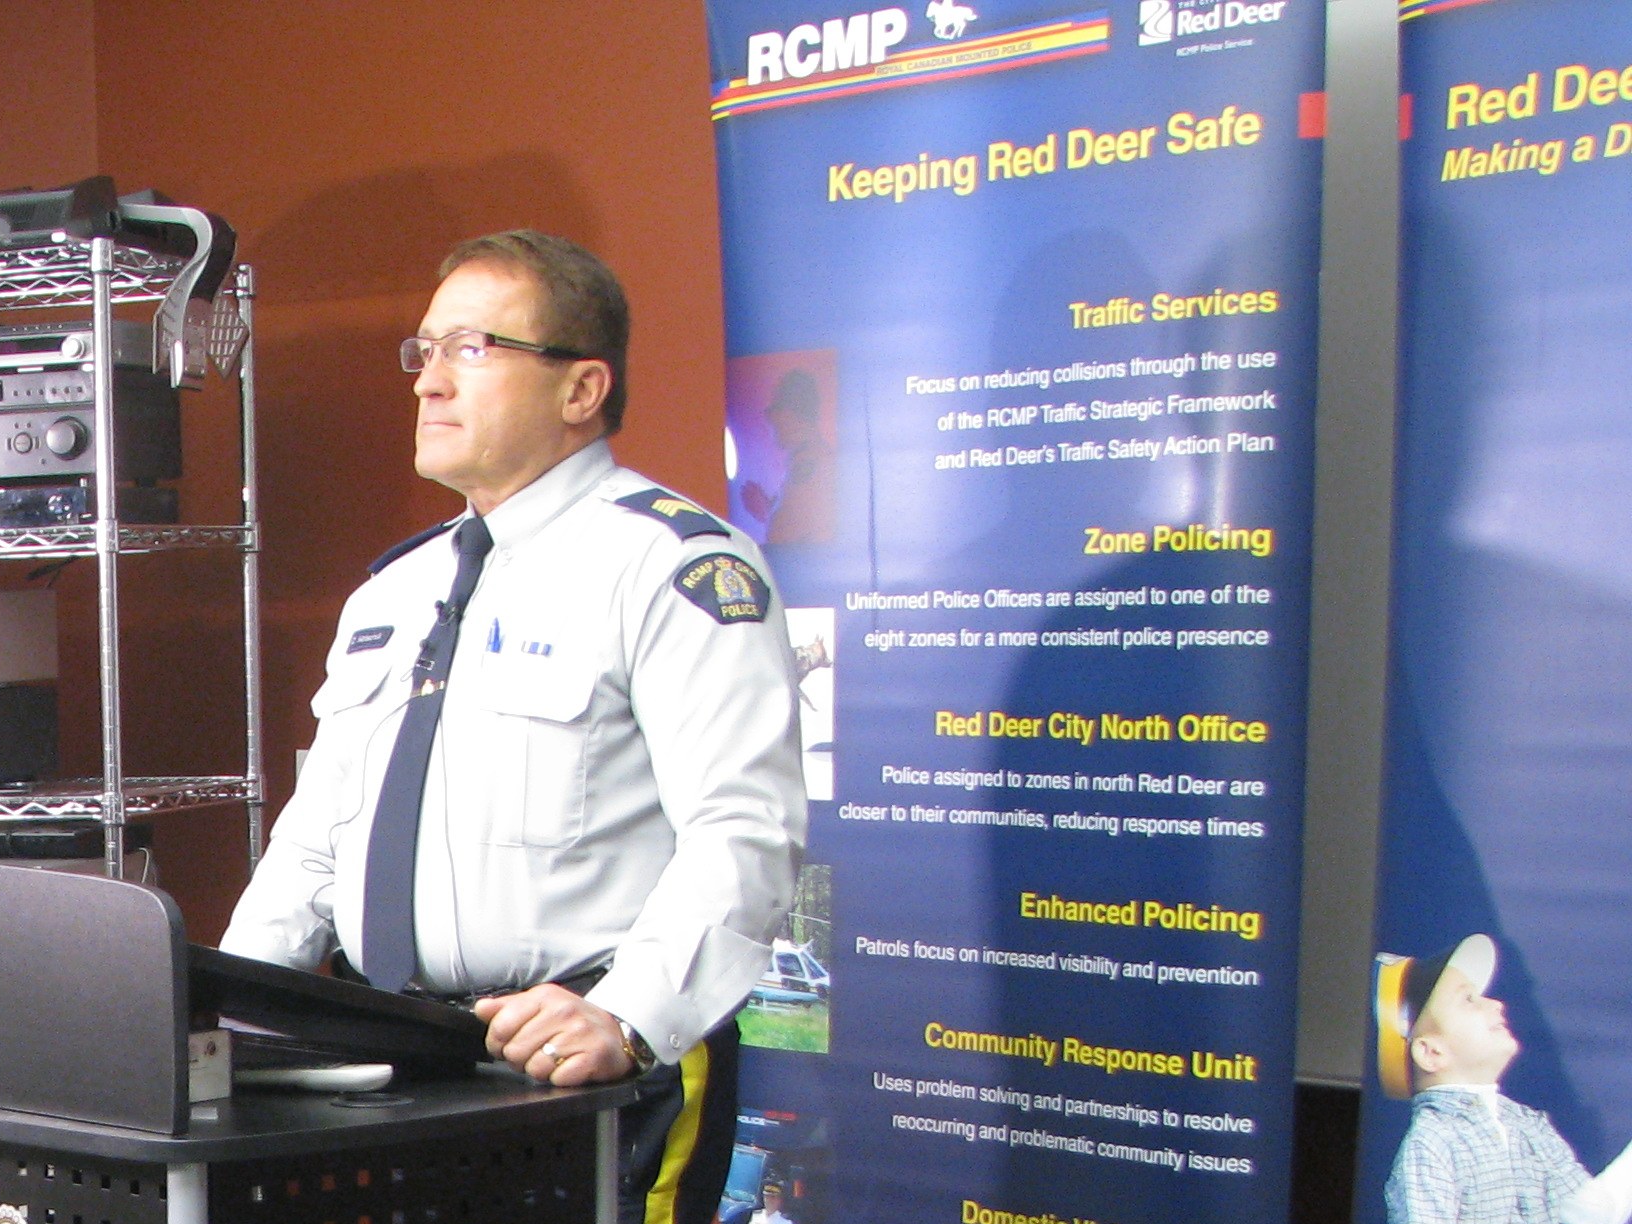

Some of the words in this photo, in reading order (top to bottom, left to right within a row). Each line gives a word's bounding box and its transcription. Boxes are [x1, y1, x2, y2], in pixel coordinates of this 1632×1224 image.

[1177, 4, 1218, 36] Red
[1225, 1, 1286, 28] Deer
[747, 8, 907, 85] RCMP
[875, 65, 903, 75] ROYAL
[907, 56, 952, 70] CANADIAN
[955, 48, 999, 64] MOUNTED
[1001, 42, 1033, 55] POLICE
[1446, 71, 1540, 130] Red
[828, 149, 977, 203] Keeping
[987, 132, 1057, 181] Red
[1066, 123, 1156, 171] Deer
[1166, 105, 1261, 154] Safe
[1441, 138, 1564, 181] Making
[1572, 135, 1596, 162] a
[1069, 297, 1144, 330] Traffic
[1151, 286, 1277, 321] Services
[906, 373, 956, 396] Focus
[960, 373, 979, 389] on
[984, 364, 1050, 392] reducing
[1053, 360, 1126, 385] collisions
[1130, 352, 1195, 382] through
[1201, 349, 1231, 370] the
[1237, 350, 1276, 368] use
[938, 409, 956, 431] of
[959, 409, 983, 429] the
[987, 404, 1037, 426] RCMP
[1041, 401, 1087, 422] Traffic
[1090, 397, 1163, 424] Strategic
[1167, 389, 1275, 414] Framework
[935, 449, 965, 468] and
[970, 446, 1002, 467] Red
[1005, 443, 1054, 464] Deer's
[1058, 439, 1104, 461] Traffic
[1107, 435, 1160, 462] Safety
[1164, 431, 1221, 456] Action
[1227, 430, 1273, 452] Plan
[1084, 528, 1146, 555] Zone
[1153, 523, 1271, 556] Policing
[682, 562, 713, 589] RCMP
[721, 604, 758, 617] POLICE
[846, 591, 929, 611] Uniformed
[933, 591, 979, 610] Police
[984, 589, 1041, 609] Officers
[1046, 592, 1070, 607] are
[1074, 587, 1146, 611] assigned
[1150, 588, 1166, 605] to
[1171, 589, 1206, 605] one
[1211, 586, 1231, 604] of
[1237, 585, 1269, 604] the
[865, 628, 905, 651] eight
[909, 631, 956, 648] zones
[960, 629, 980, 647] for
[984, 631, 994, 646] a
[998, 630, 1037, 646] more
[1041, 628, 1119, 646] consistent
[1122, 628, 1172, 650] police
[1177, 629, 1268, 650] presence
[935, 711, 981, 737] Red
[988, 712, 1041, 738] Deer
[1048, 713, 1094, 746] City
[1101, 715, 1170, 742] North
[1177, 713, 1266, 743] Office
[882, 766, 929, 785] Police
[933, 767, 1003, 791] assigned
[1007, 771, 1021, 788] to
[1025, 773, 1070, 789] zones
[1075, 772, 1088, 789] in
[1092, 772, 1134, 792] north
[1138, 773, 1174, 793] Red
[1178, 776, 1224, 794] Deer
[1230, 780, 1264, 795] are
[839, 803, 888, 821] closer
[892, 804, 906, 822] to
[910, 804, 946, 822] their
[949, 806, 1048, 830] communities,
[1053, 812, 1119, 835] reducing
[1122, 816, 1201, 838] response
[1206, 816, 1263, 838] times
[1020, 892, 1136, 926] Enhanced
[1143, 901, 1260, 939] Policing
[856, 937, 909, 958] Patrols
[913, 940, 955, 960] focus
[958, 946, 978, 962] on
[983, 946, 1055, 969] increased
[1059, 954, 1119, 980] visibility
[1122, 959, 1153, 979] and
[1158, 963, 1258, 986] prevention
[925, 1022, 1056, 1066] Community
[1062, 1036, 1183, 1076] Response
[1191, 1051, 1256, 1081] Unit
[874, 1072, 912, 1092] Uses
[916, 1076, 976, 1099] problem
[979, 1084, 1030, 1111] solving
[1034, 1091, 1061, 1112] and
[1065, 1094, 1158, 1125] partnerships
[1163, 1107, 1178, 1127] to
[1183, 1111, 1253, 1133] resolve
[893, 1113, 975, 1141] reoccurring
[978, 1121, 1006, 1142] and
[1010, 1125, 1094, 1156] problematic
[1098, 1138, 1184, 1172] community
[1188, 1150, 1250, 1173] issues
